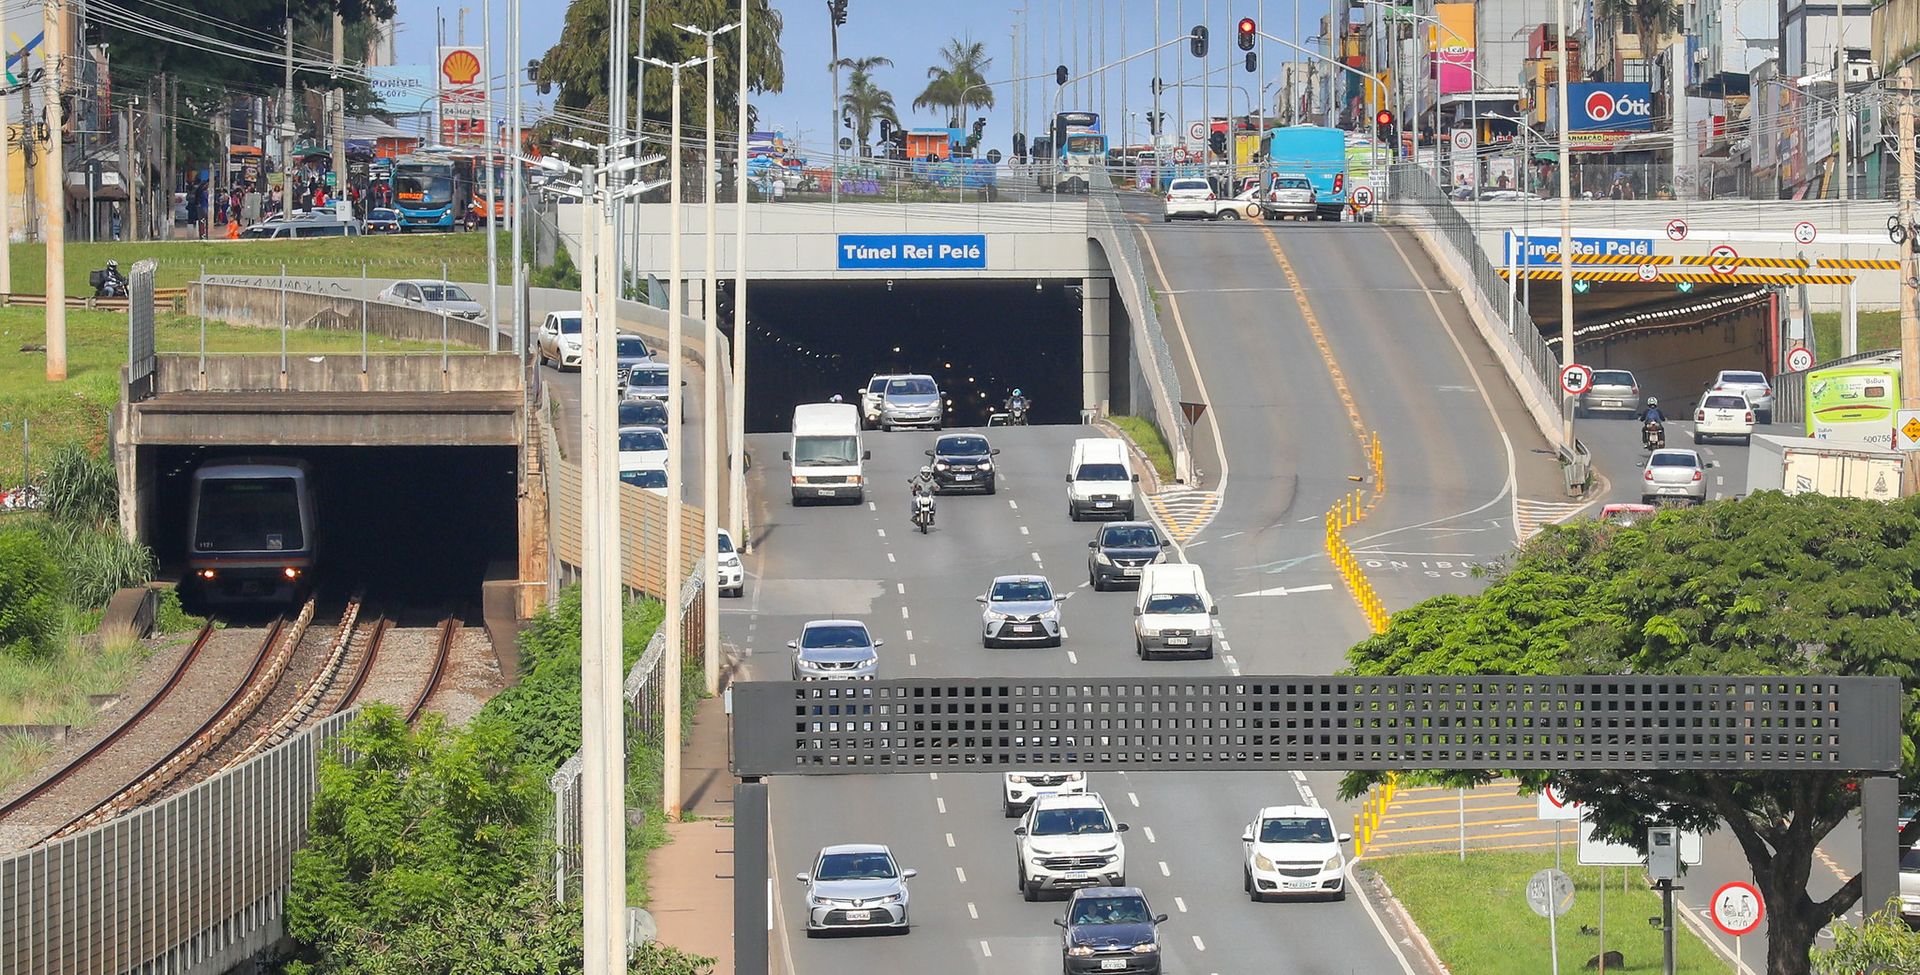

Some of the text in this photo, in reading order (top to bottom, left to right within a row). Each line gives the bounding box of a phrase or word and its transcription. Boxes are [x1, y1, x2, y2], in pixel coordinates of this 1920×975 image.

[844, 244, 981, 259] Túnel Rei Pelé
[1515, 242, 1562, 255] Túnel
[1572, 241, 1600, 256] Rei
[1793, 356, 1807, 365] 60
